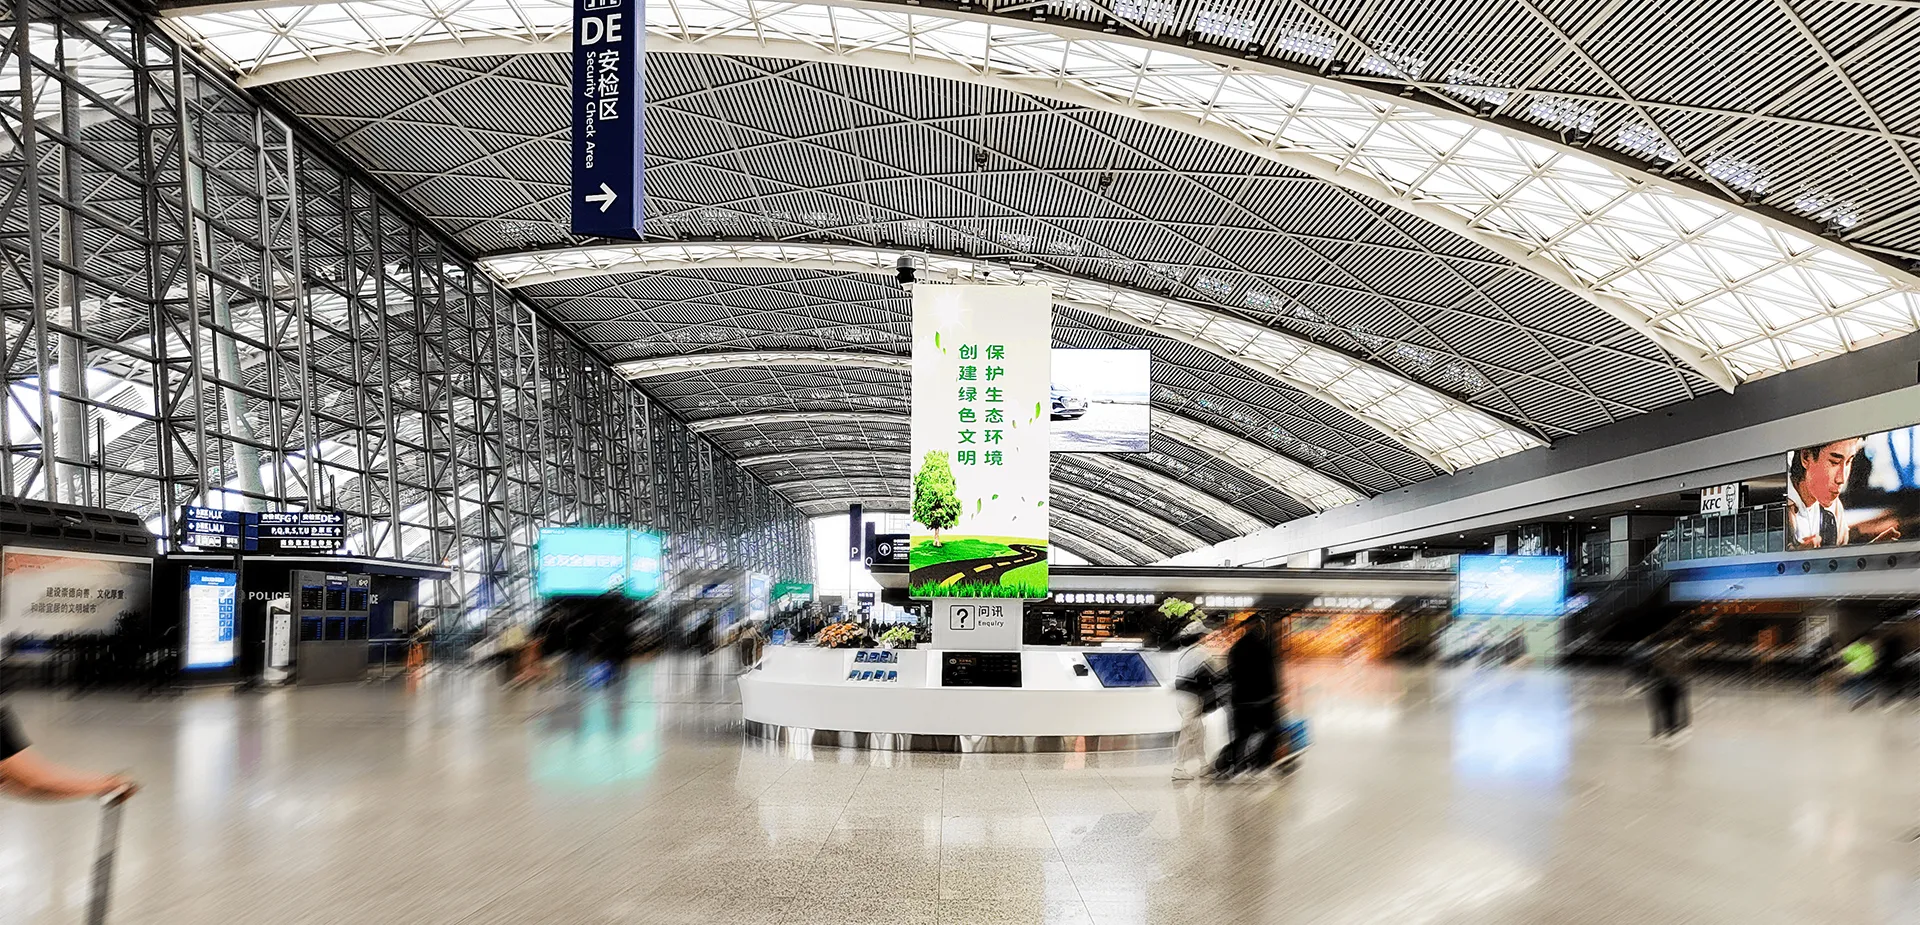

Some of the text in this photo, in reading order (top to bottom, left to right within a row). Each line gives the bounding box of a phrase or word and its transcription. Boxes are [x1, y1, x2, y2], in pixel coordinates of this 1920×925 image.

[581, 13, 622, 46] DE
[597, 49, 620, 121] 安检区
[584, 51, 596, 169] Security Check Area
[957, 344, 978, 466] 创建绿色文明
[984, 344, 1005, 466] 保护生态环境
[1702, 498, 1721, 510] KFC
[851, 547, 859, 558] P
[248, 592, 290, 600] POLICE
[978, 605, 1004, 617] 问讯
